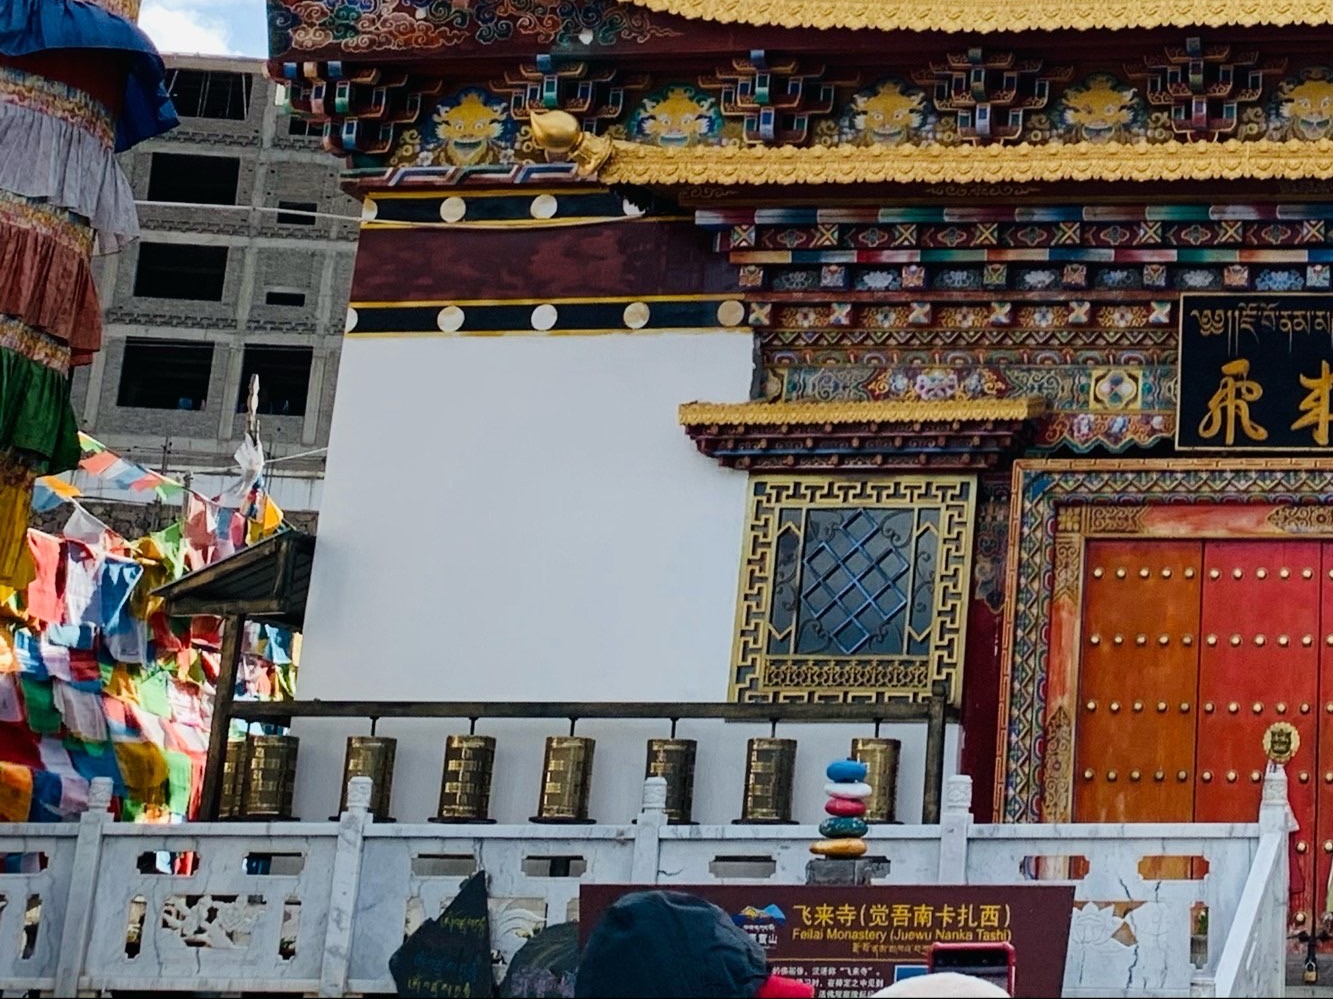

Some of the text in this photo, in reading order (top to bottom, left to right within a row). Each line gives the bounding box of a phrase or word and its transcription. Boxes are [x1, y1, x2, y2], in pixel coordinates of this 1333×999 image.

[792, 928, 824, 941] Feilai
[827, 928, 888, 943] Monastery
[890, 928, 932, 942] (Juewu
[935, 928, 973, 941] Nanka
[976, 928, 1012, 942] Tashi)
